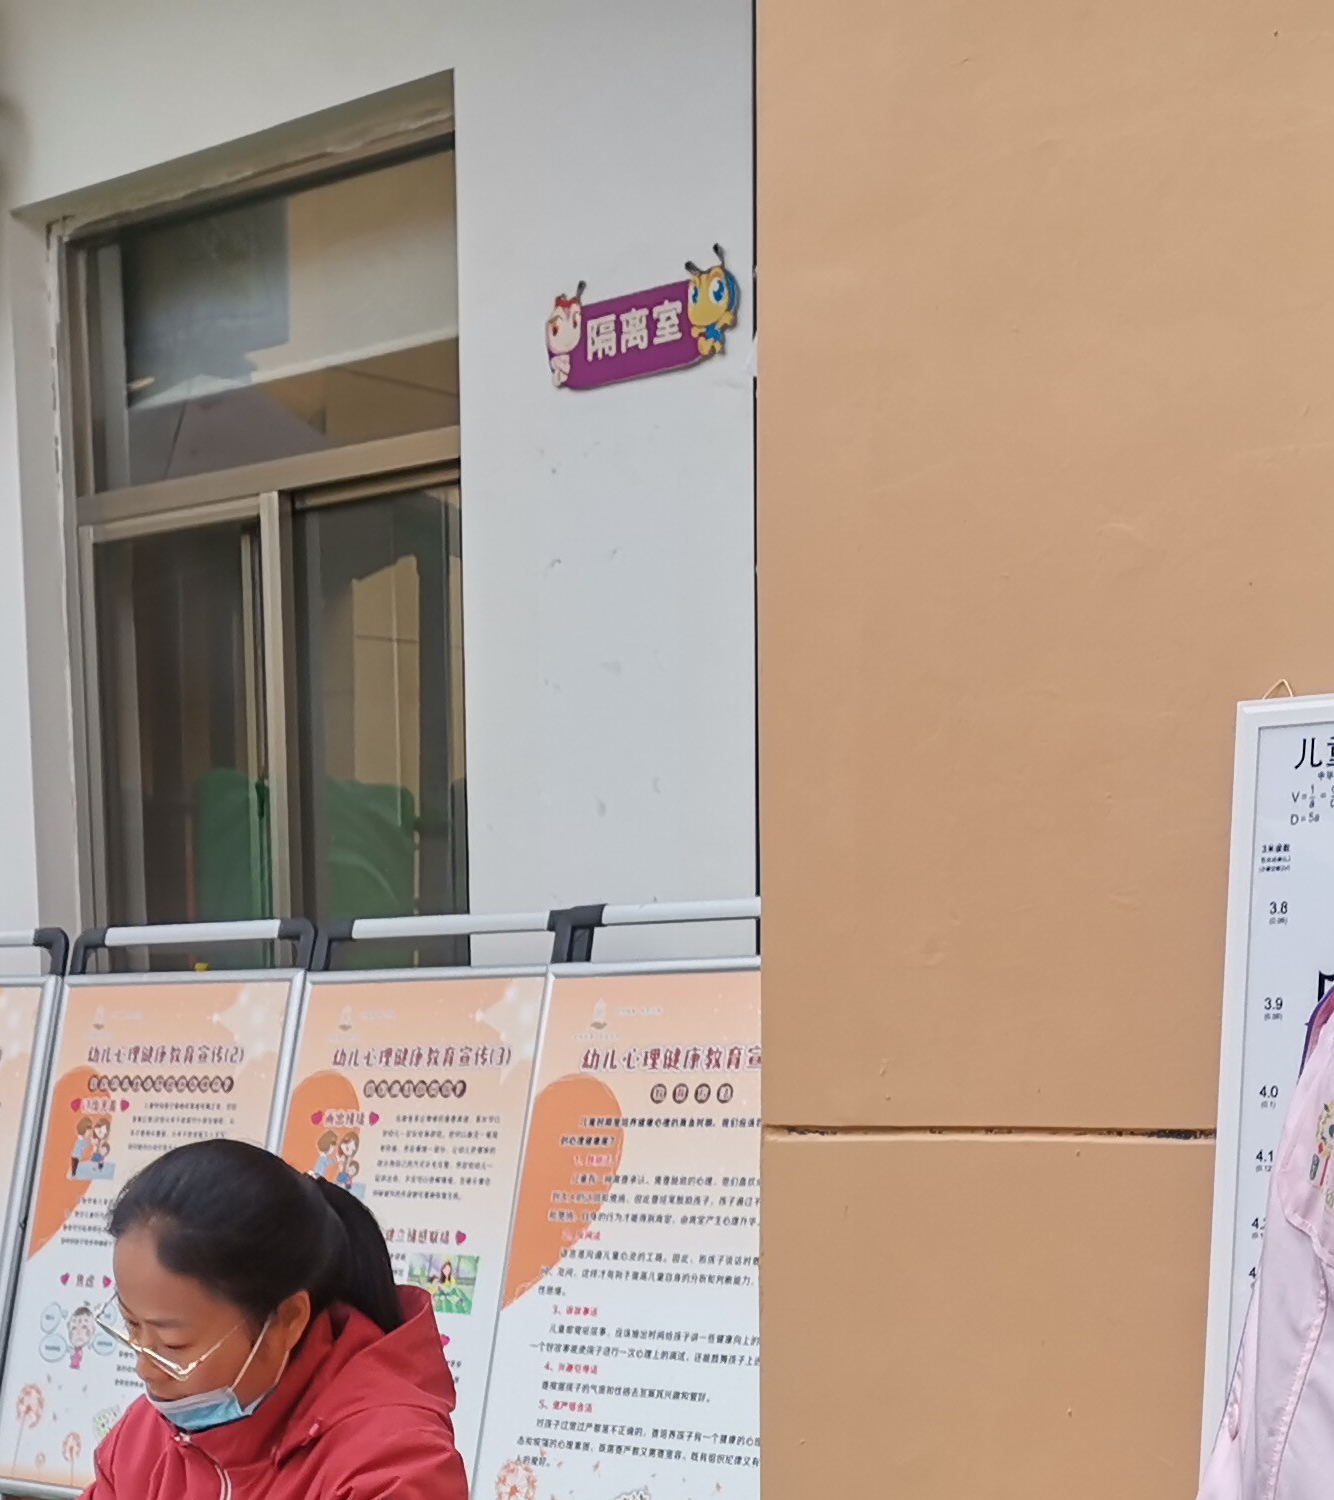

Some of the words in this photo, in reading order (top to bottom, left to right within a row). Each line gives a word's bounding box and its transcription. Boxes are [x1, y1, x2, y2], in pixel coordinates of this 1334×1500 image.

[586, 299, 683, 362] 隔离室
[1269, 901, 1288, 915] 3.8
[1264, 997, 1283, 1010] 3.9
[1259, 1085, 1279, 1099] 4.0
[1255, 1149, 1274, 1162] 4.1
